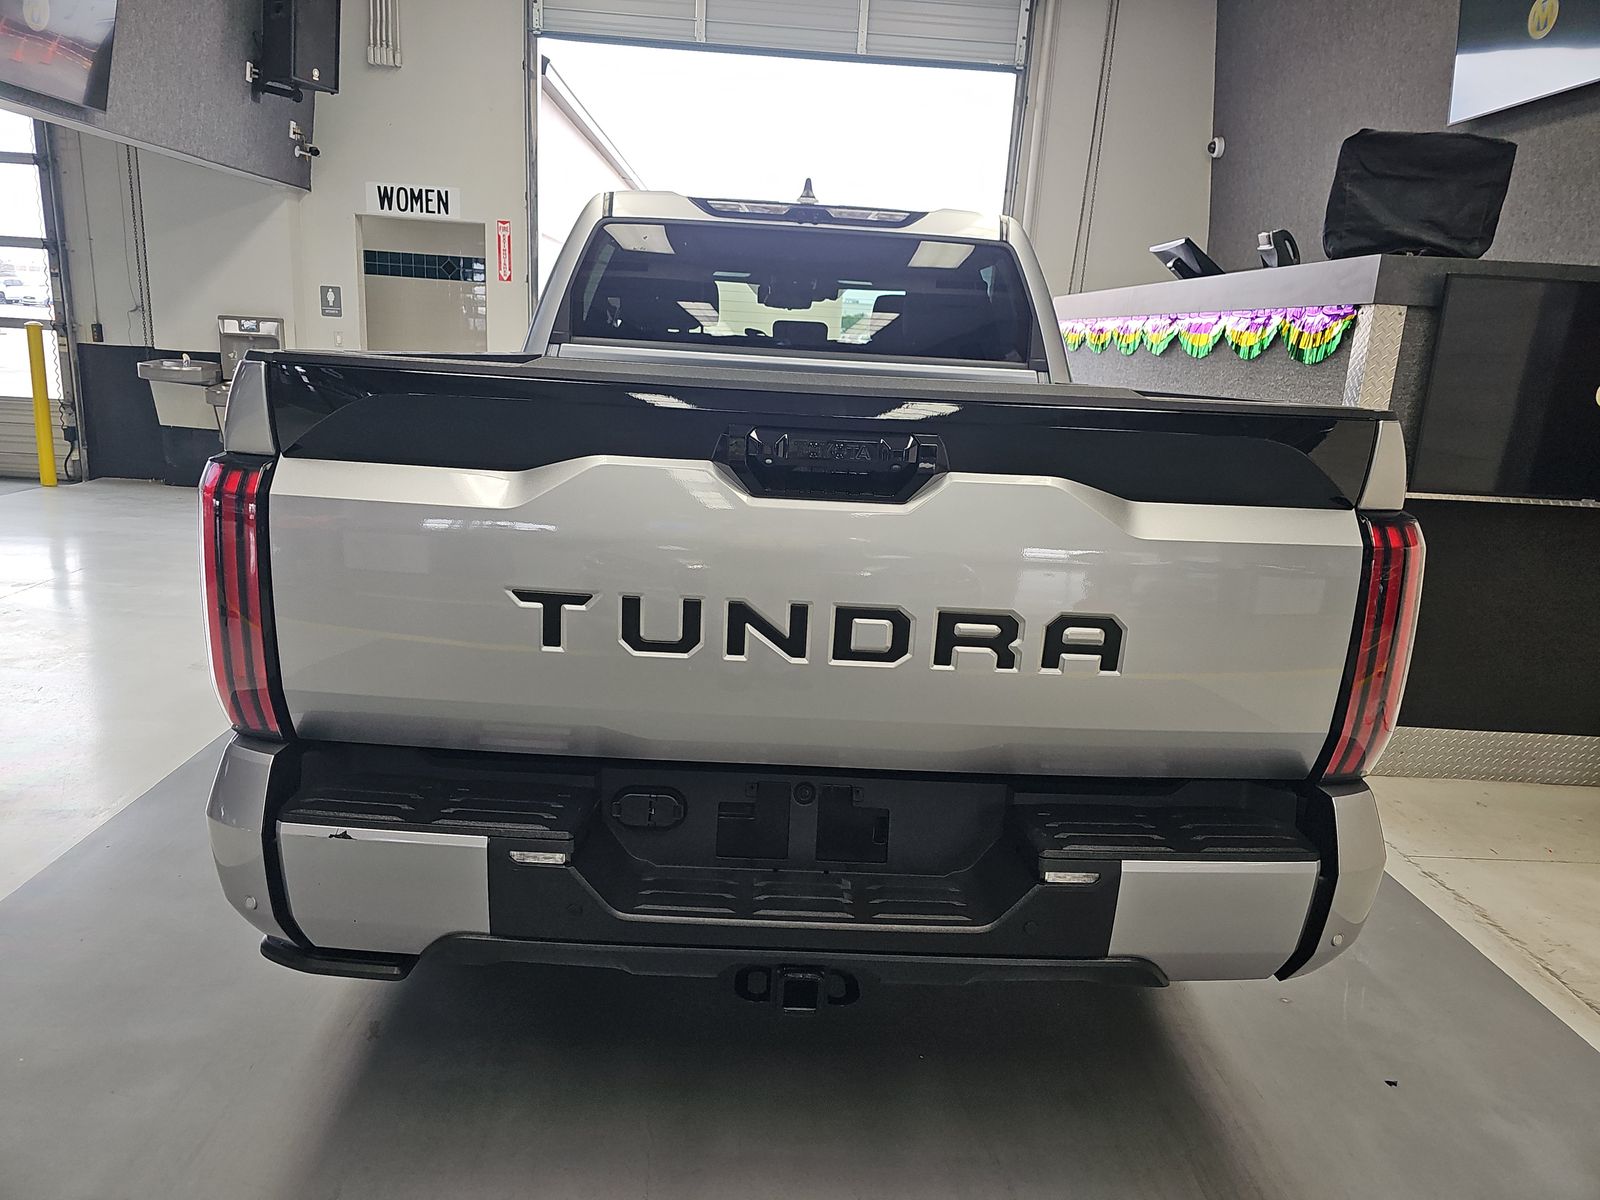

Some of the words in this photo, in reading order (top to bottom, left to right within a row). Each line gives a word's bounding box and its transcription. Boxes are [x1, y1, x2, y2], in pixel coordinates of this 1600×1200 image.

[377, 185, 450, 215] WOMEN
[792, 440, 872, 462] OYOTA
[506, 587, 1128, 677] TUNDRA
